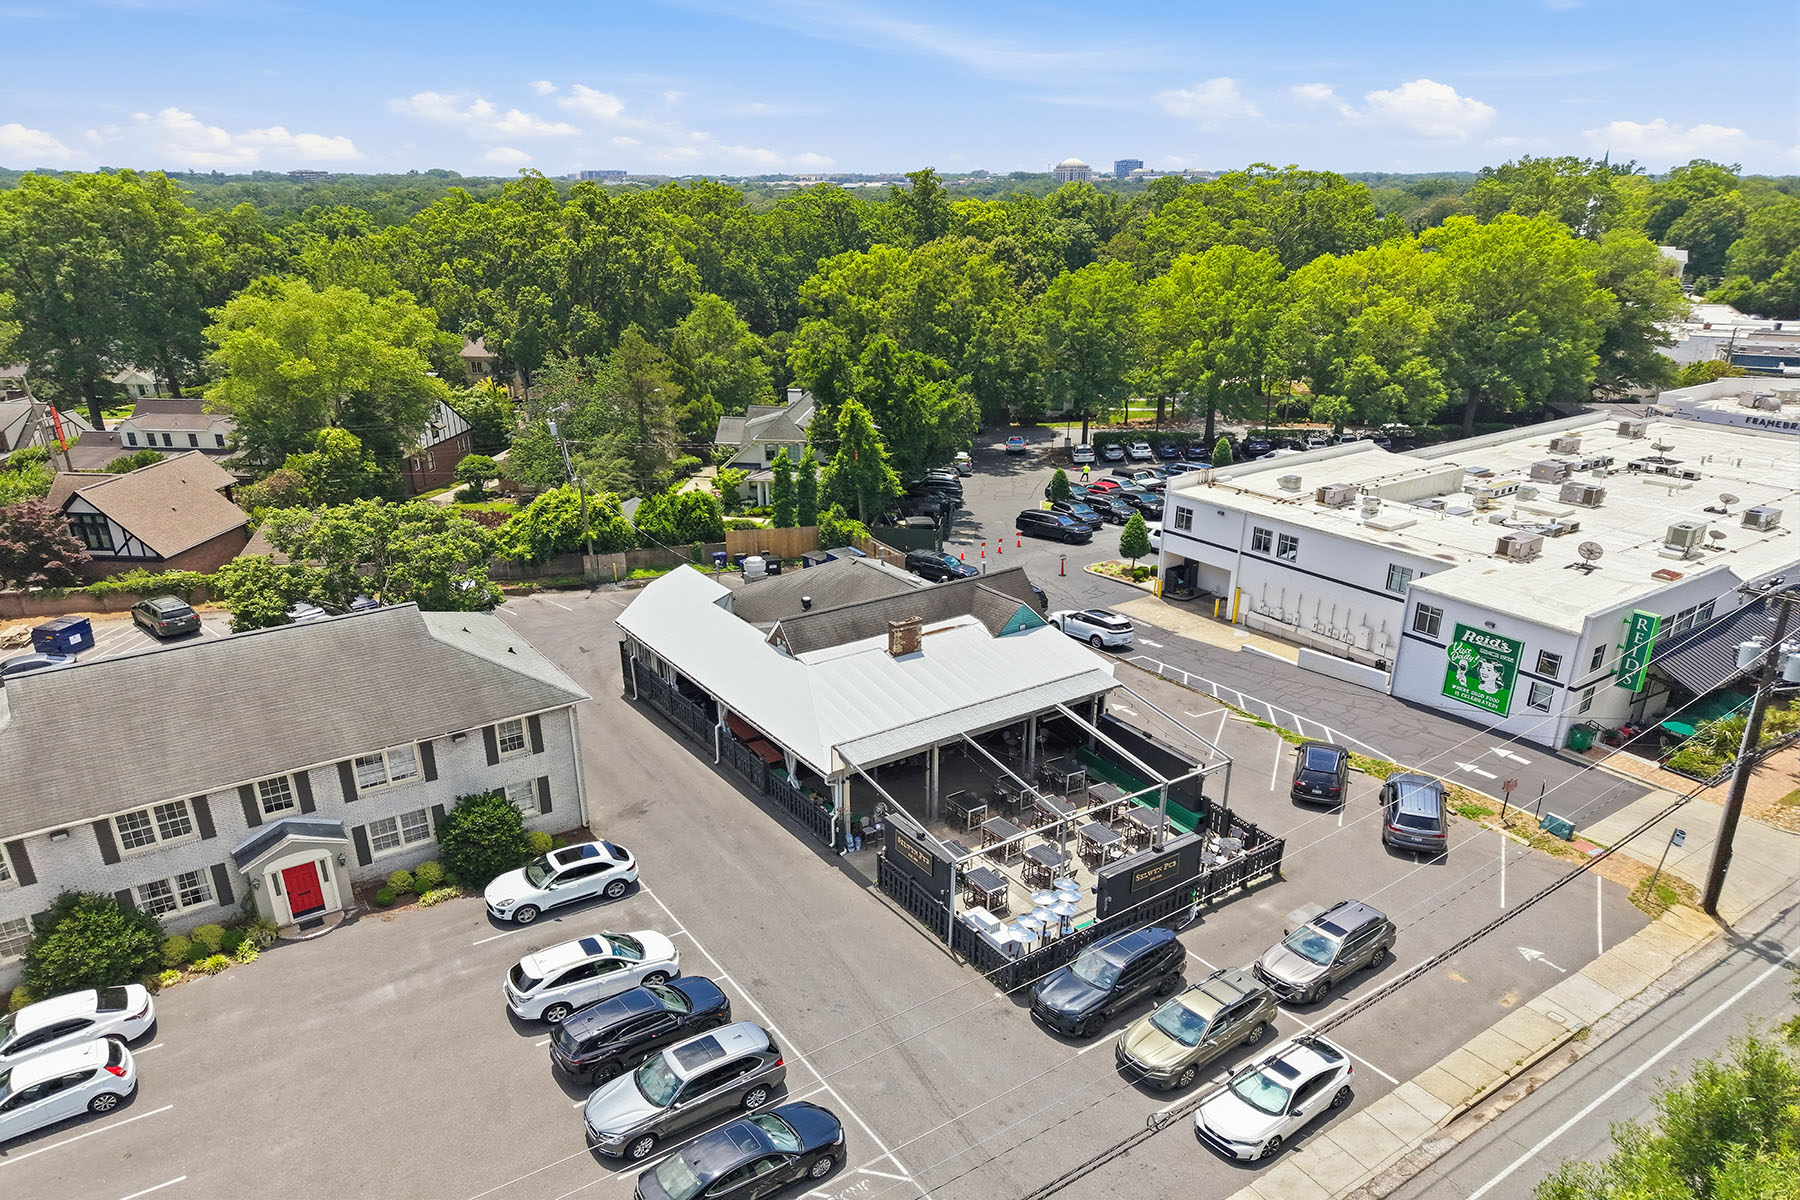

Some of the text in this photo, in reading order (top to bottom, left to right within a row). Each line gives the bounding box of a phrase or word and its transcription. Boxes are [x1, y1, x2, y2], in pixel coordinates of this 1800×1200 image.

[1745, 416, 1800, 430] FRAMEBR
[1453, 642, 1472, 654] Visit
[1461, 630, 1512, 653] Reid's
[1450, 651, 1480, 663] Daily!
[1452, 684, 1500, 703] WHERE GOOD FOOD
